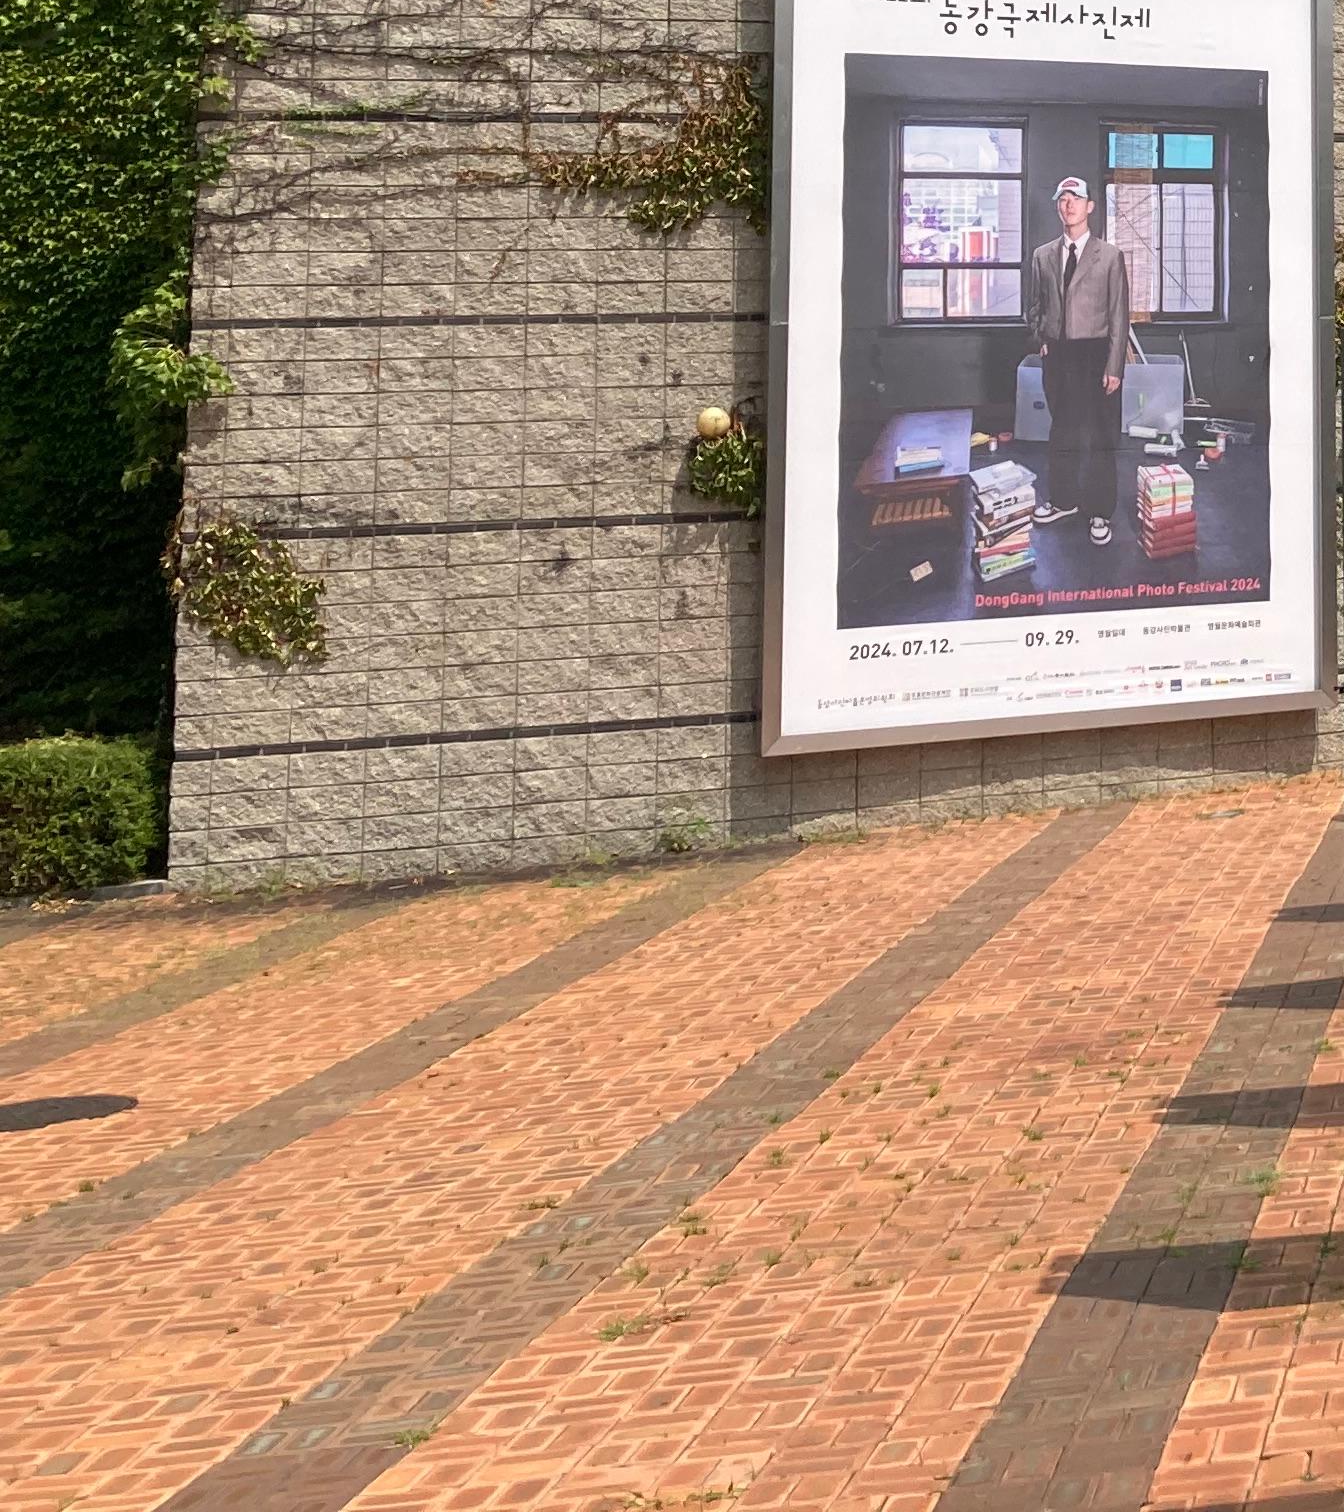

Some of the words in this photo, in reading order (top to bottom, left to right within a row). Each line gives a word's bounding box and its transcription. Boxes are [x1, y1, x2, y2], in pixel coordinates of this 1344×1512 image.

[975, 590, 1044, 609] DongGang
[1048, 585, 1134, 602] International
[1137, 583, 1175, 597] Photo
[1178, 580, 1228, 595] Festival
[1230, 577, 1262, 592] 2024
[848, 641, 897, 661] 2024.
[902, 638, 955, 657] 07.12.
